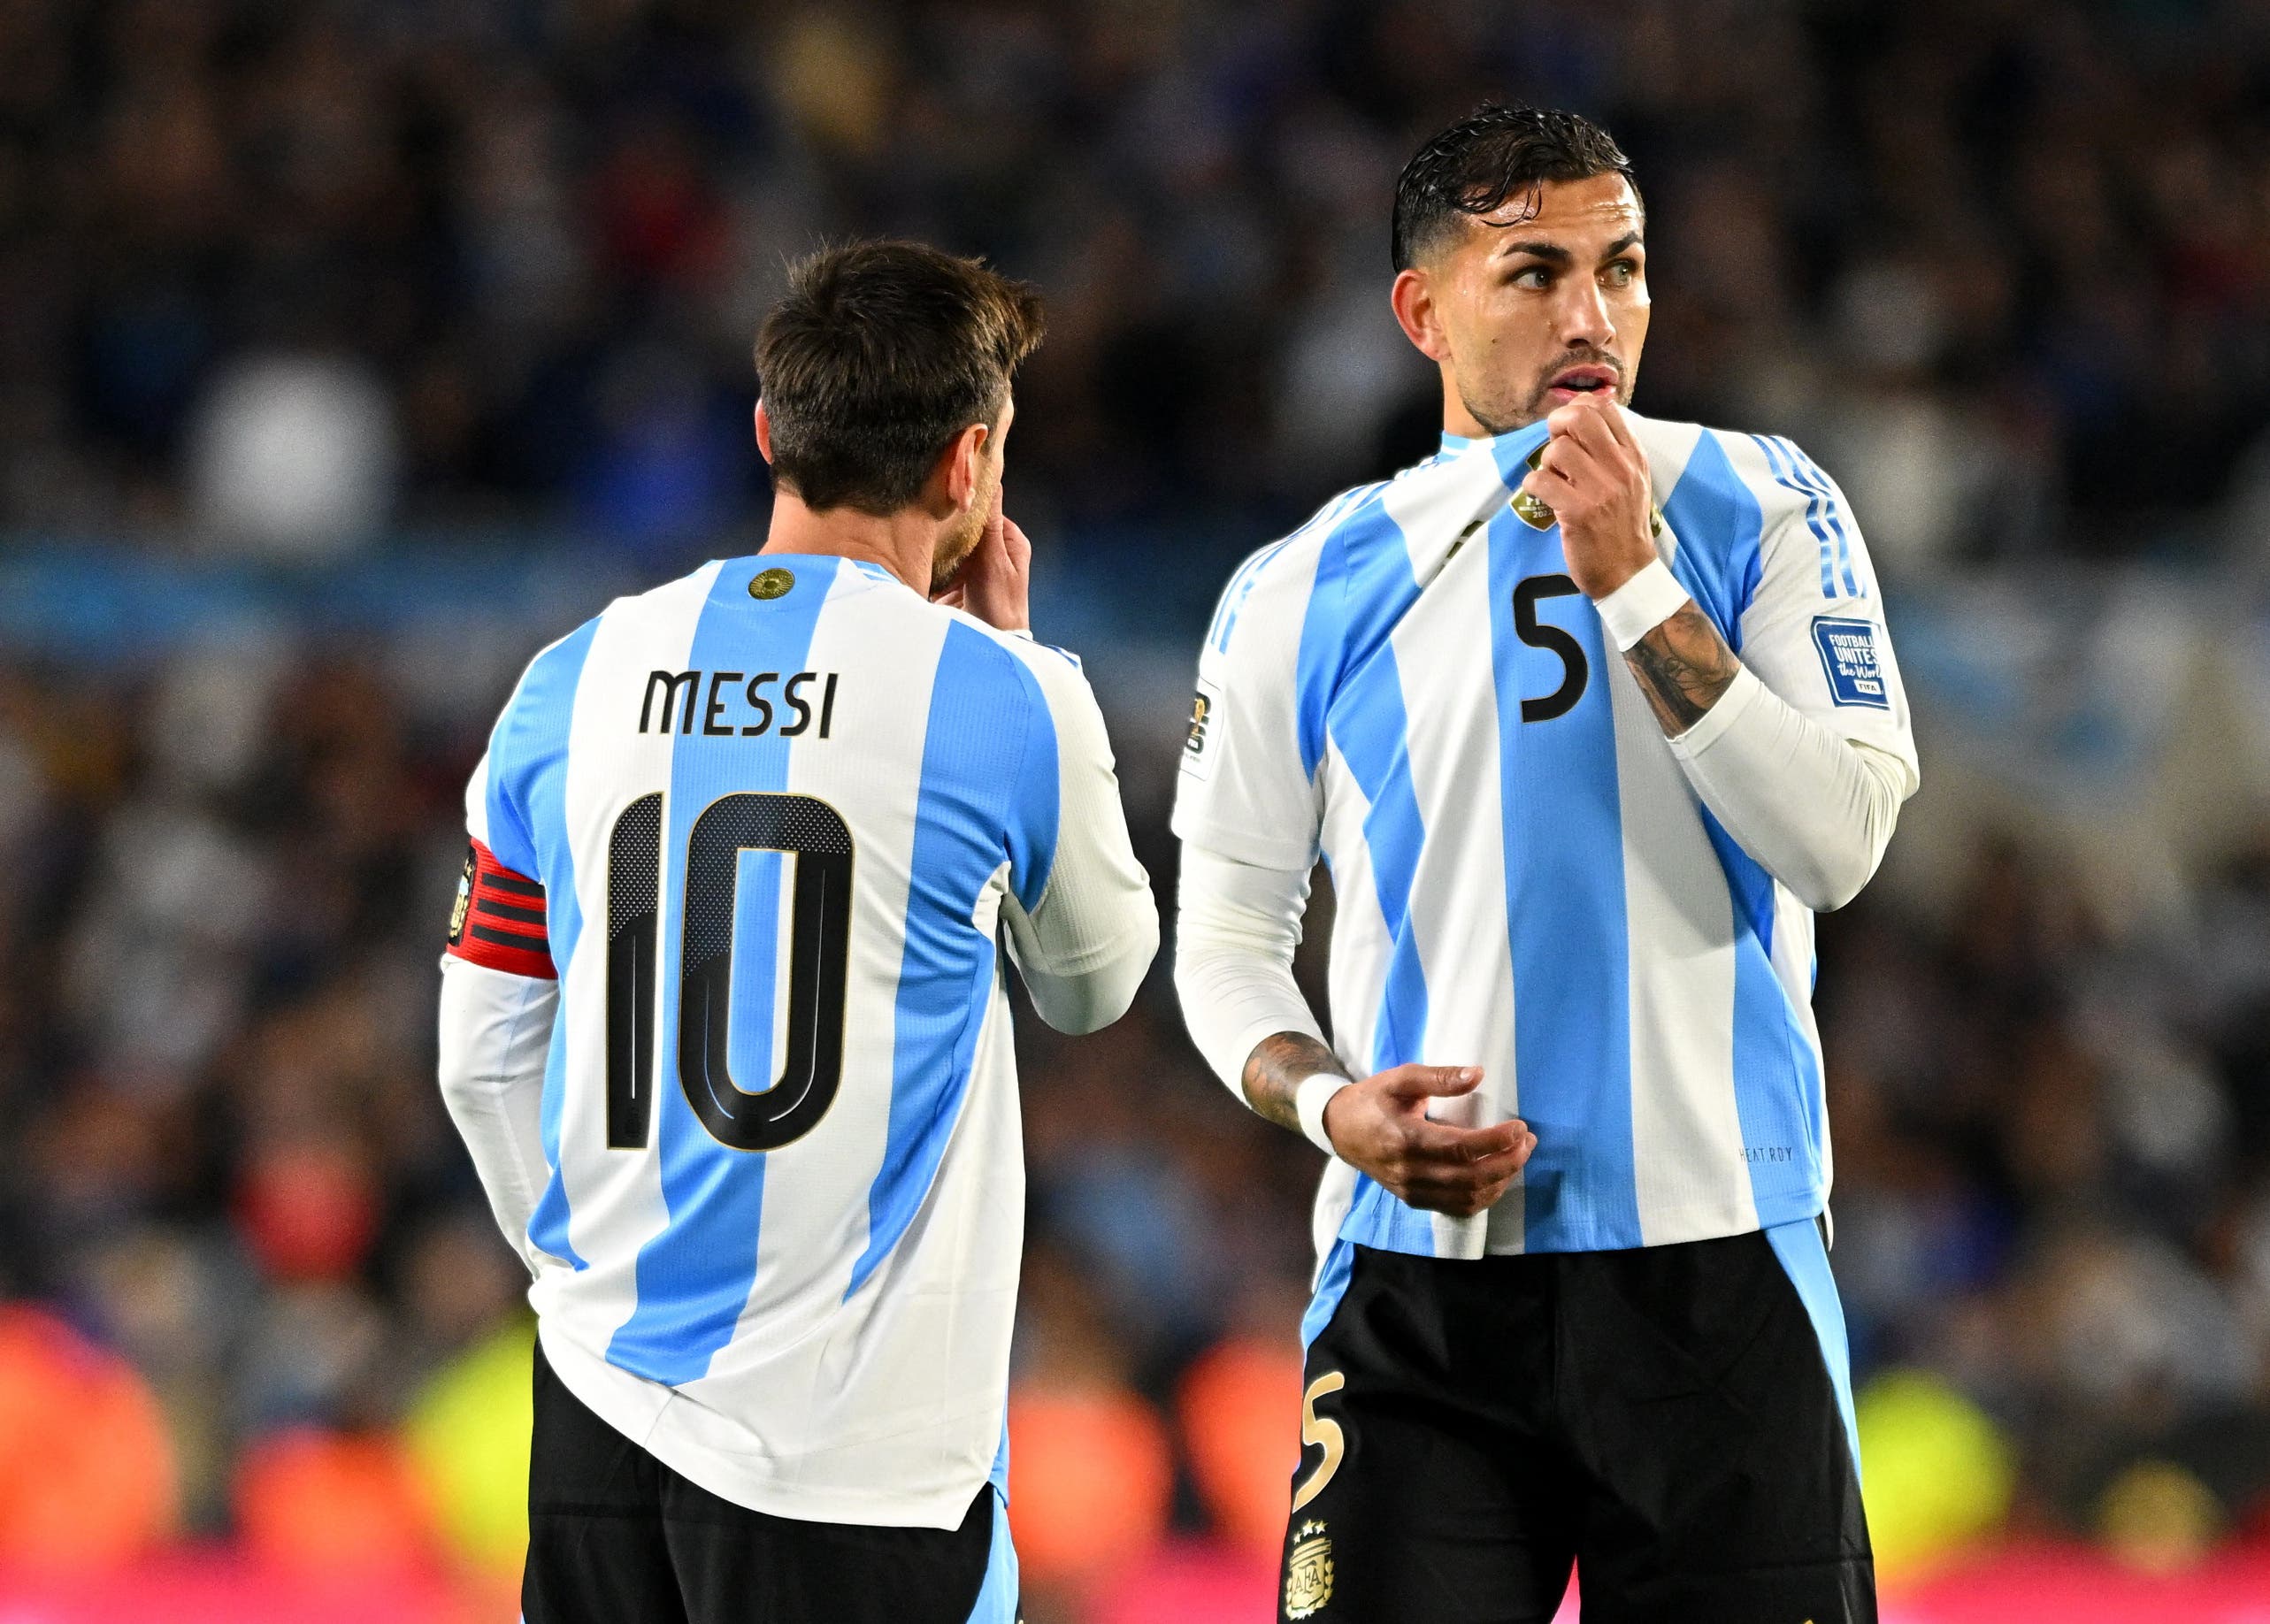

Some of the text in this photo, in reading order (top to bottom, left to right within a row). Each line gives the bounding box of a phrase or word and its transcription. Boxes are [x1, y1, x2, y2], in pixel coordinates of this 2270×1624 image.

[1513, 572, 1589, 724] 5
[1833, 647, 1878, 664] UNITES
[1837, 663, 1882, 678] the Worl
[639, 670, 839, 739] MESSI
[1859, 683, 1876, 692] FIFA
[606, 791, 856, 1152] 10
[1292, 1371, 1345, 1514] 5
[1292, 1559, 1322, 1595] AFA
